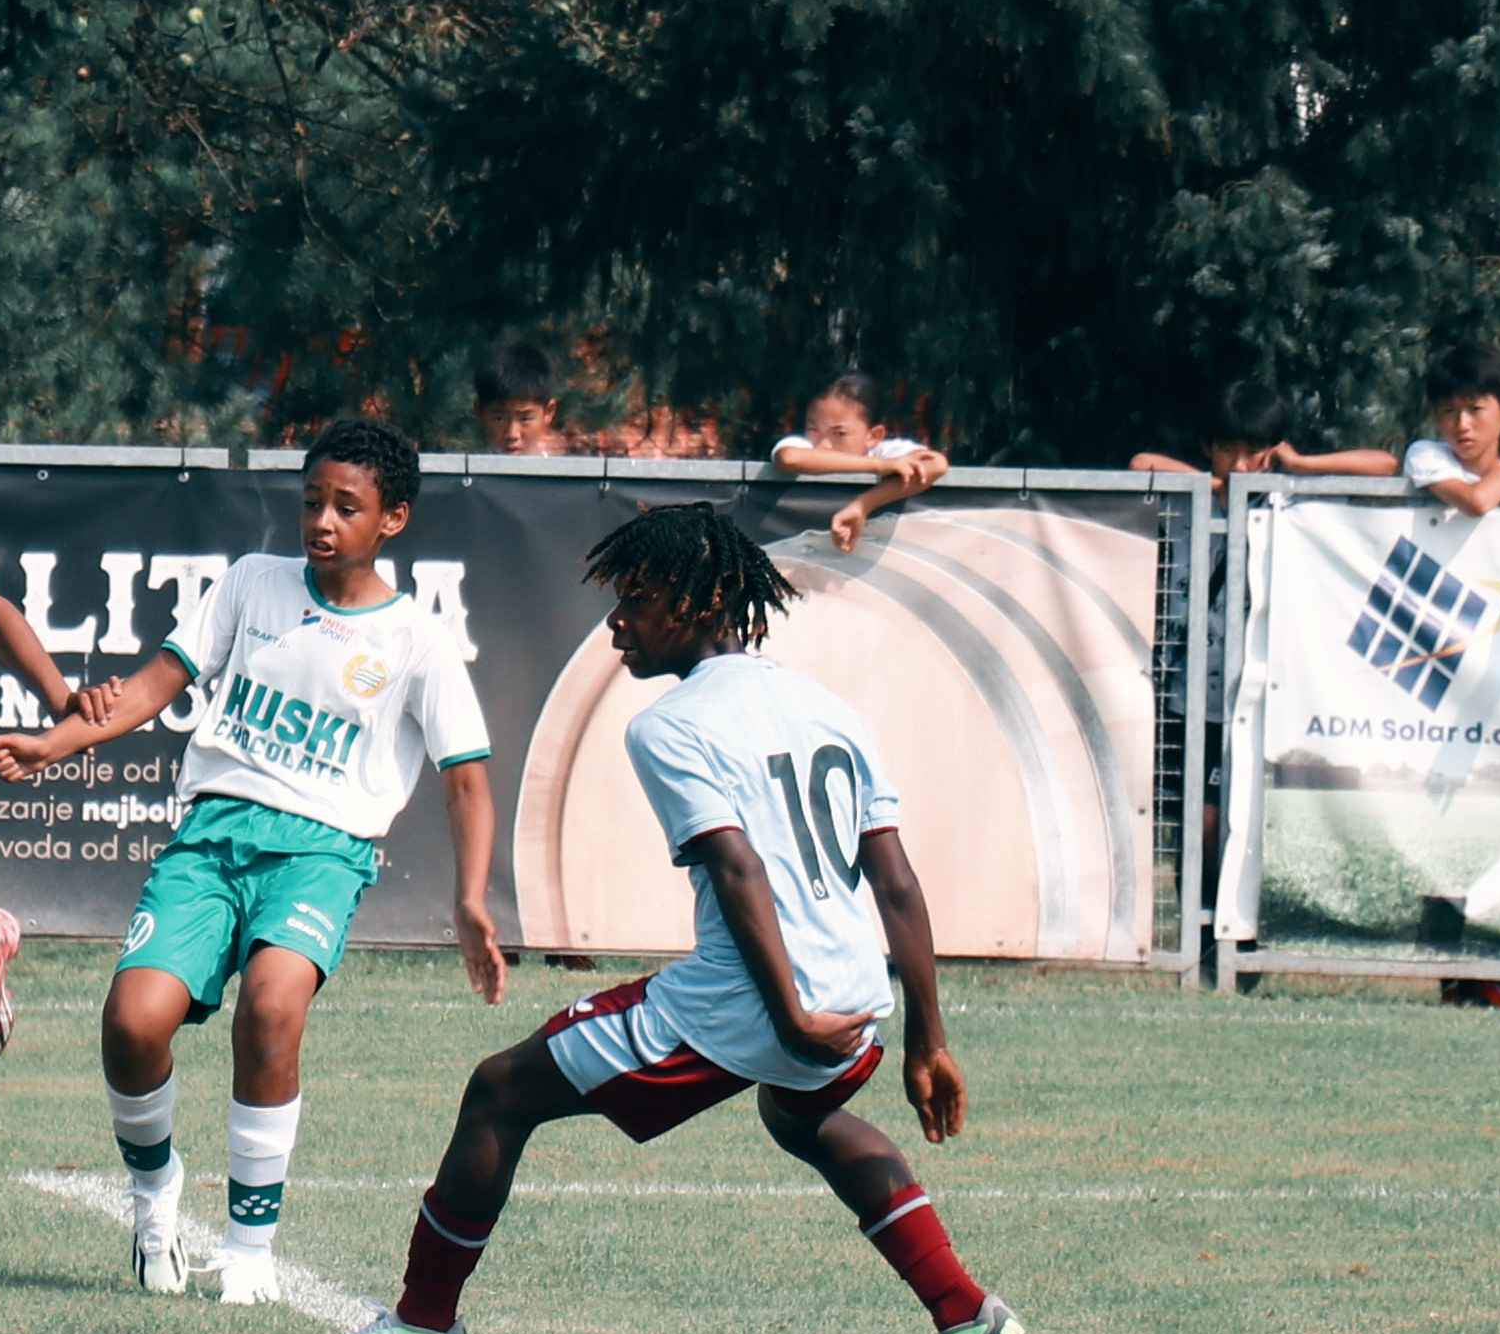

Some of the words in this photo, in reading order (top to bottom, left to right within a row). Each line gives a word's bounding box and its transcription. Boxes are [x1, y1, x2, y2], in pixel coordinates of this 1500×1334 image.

[223, 673, 360, 765] HUSKI
[1306, 715, 1372, 738] ADM
[1382, 719, 1460, 743] Solar
[123, 756, 160, 783] od
[214, 720, 346, 786] CHOCOLATE
[767, 744, 862, 901] 10
[81, 834, 118, 861] od
